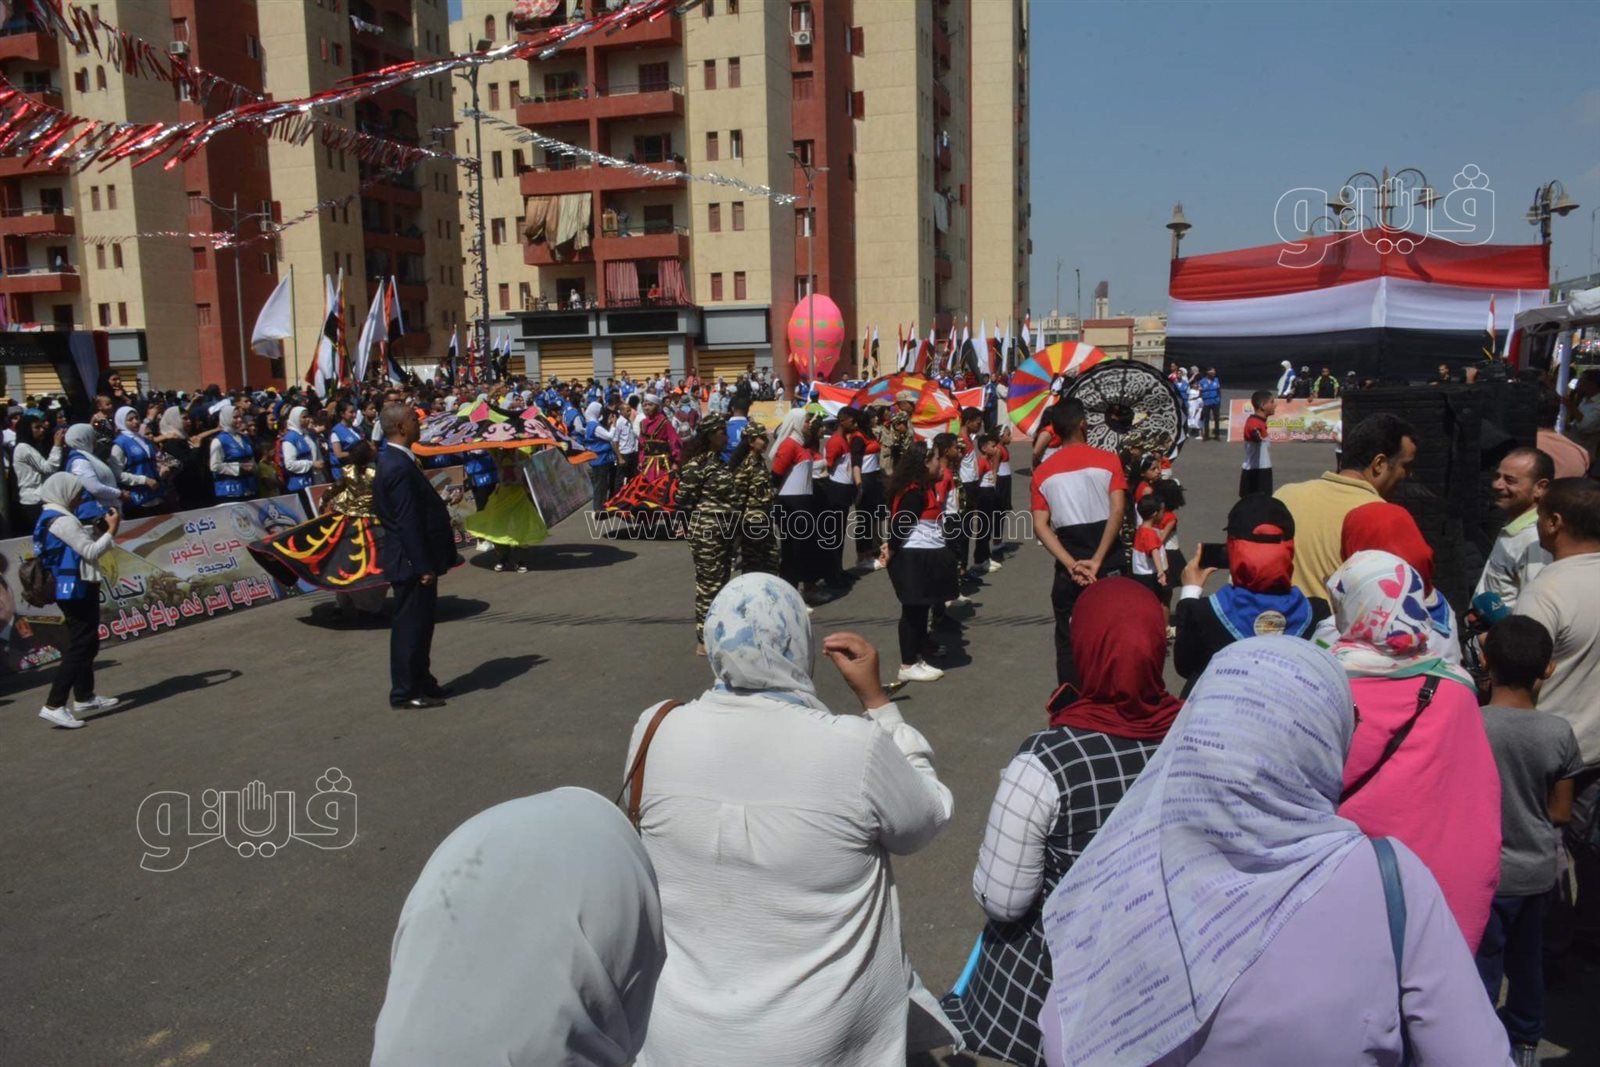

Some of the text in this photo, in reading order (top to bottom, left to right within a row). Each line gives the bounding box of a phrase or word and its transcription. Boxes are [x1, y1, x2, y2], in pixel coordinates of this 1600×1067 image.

[185, 517, 216, 535] ذكرى
[170, 539, 242, 564] حرب أكتوبر
[197, 556, 239, 574] المجيدة
[111, 607, 147, 639] شباب
[143, 600, 180, 631] مراكز
